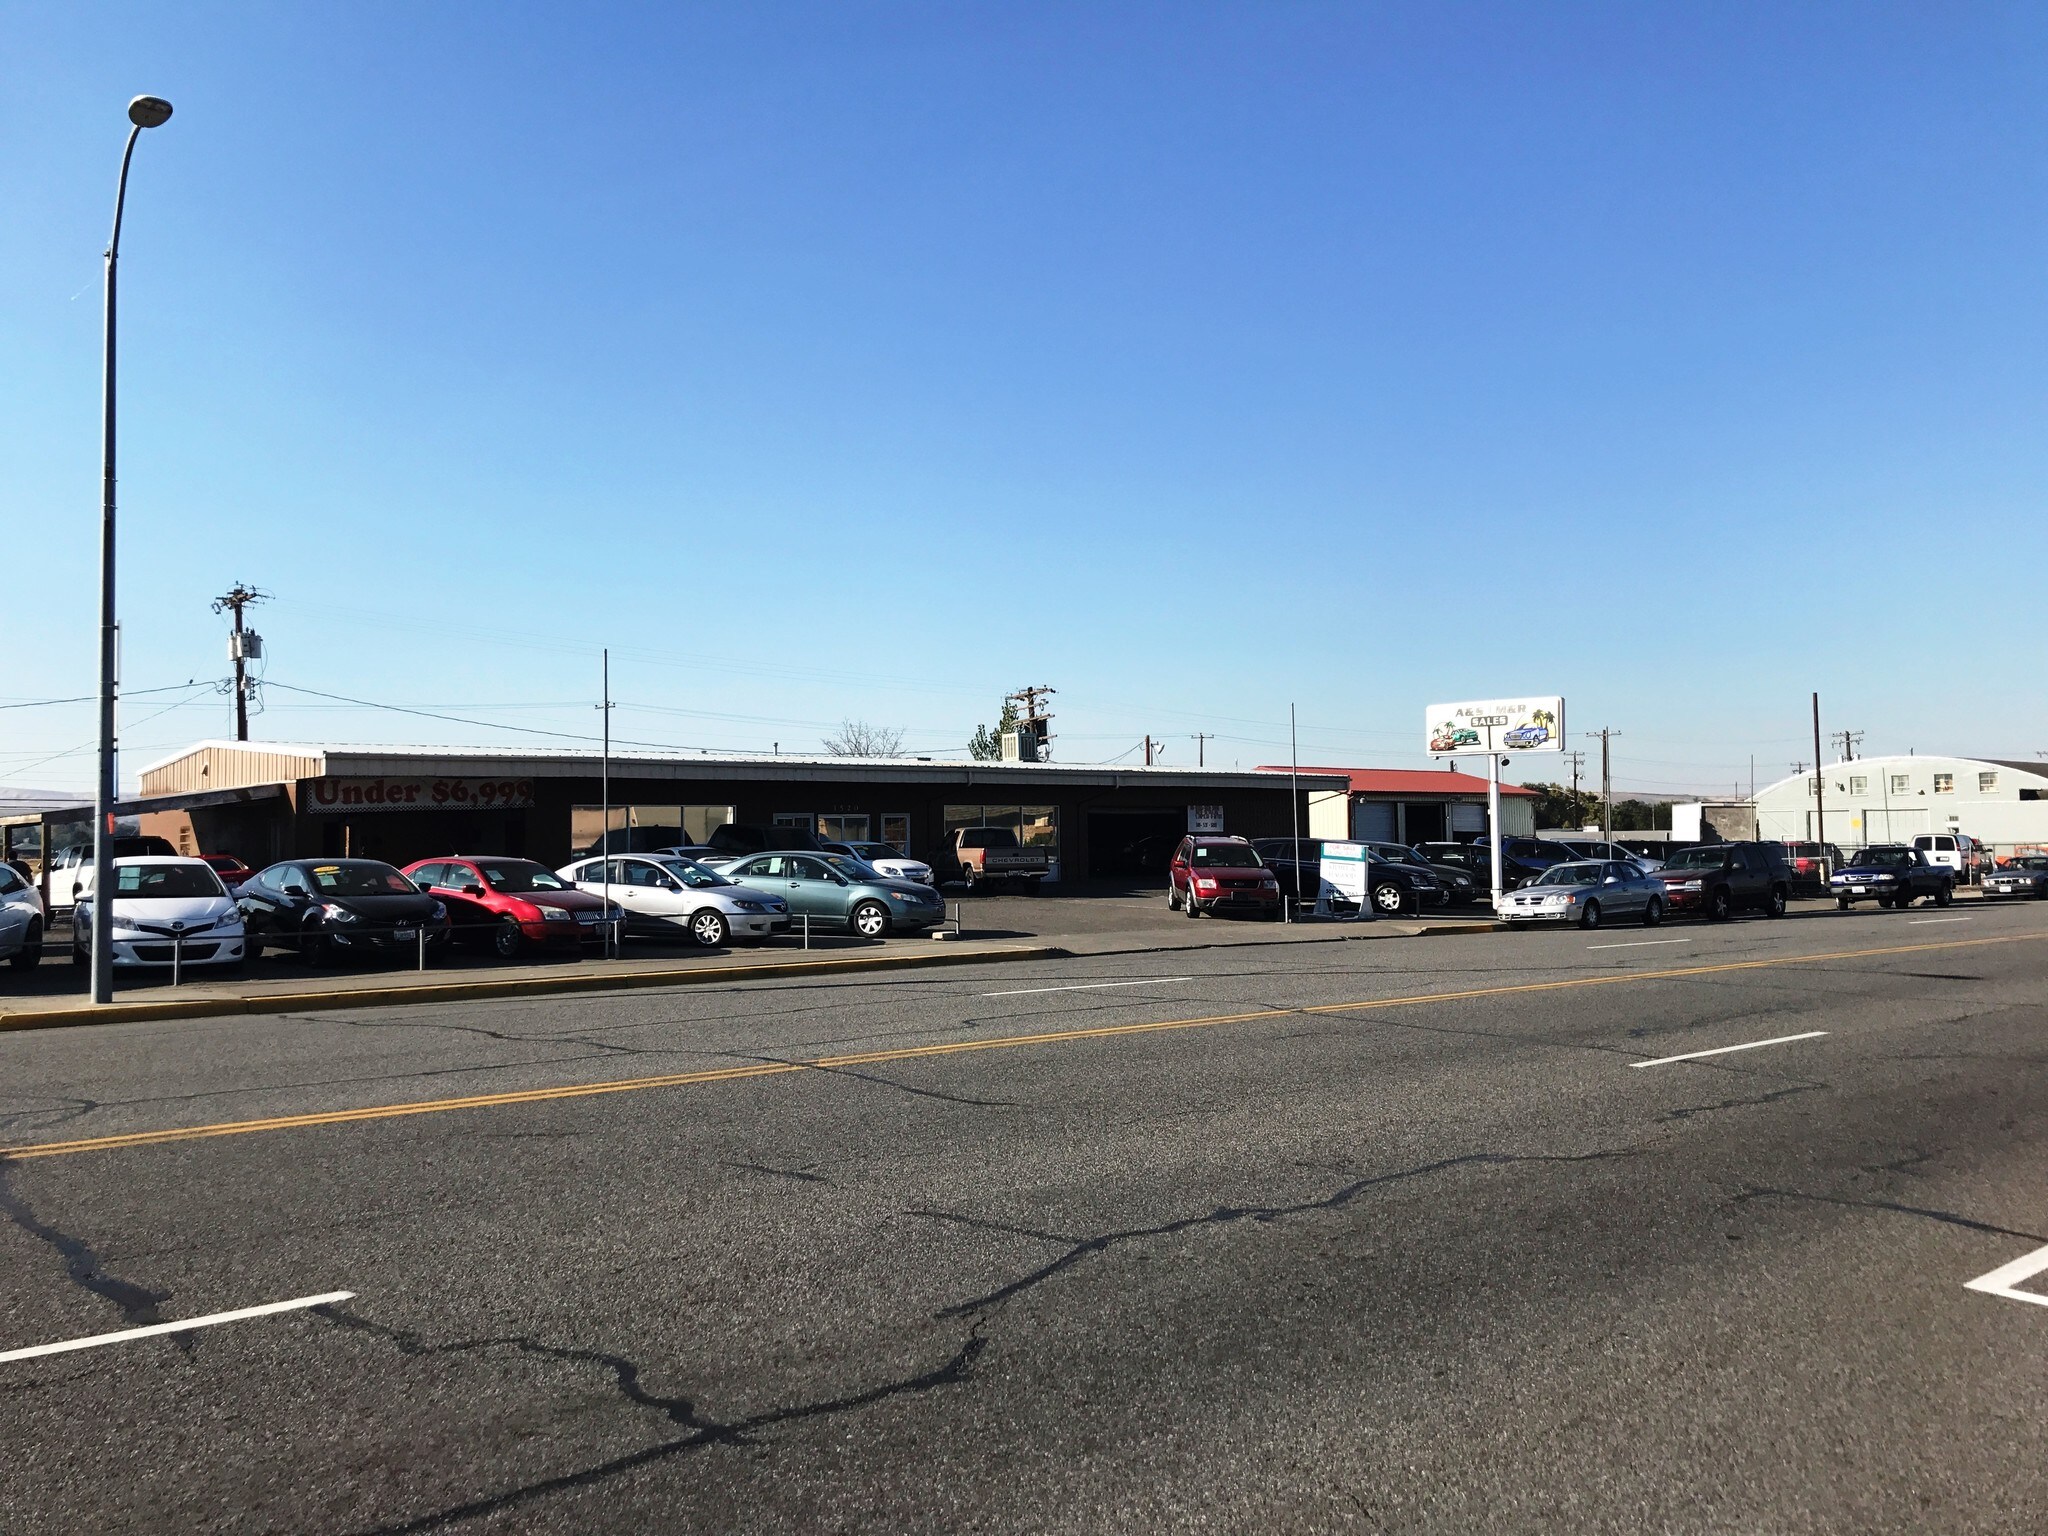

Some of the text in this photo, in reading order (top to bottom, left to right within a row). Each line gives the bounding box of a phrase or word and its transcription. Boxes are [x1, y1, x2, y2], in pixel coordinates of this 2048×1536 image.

[1472, 716, 1506, 726] SALES
[313, 778, 534, 806] Under $6,999
